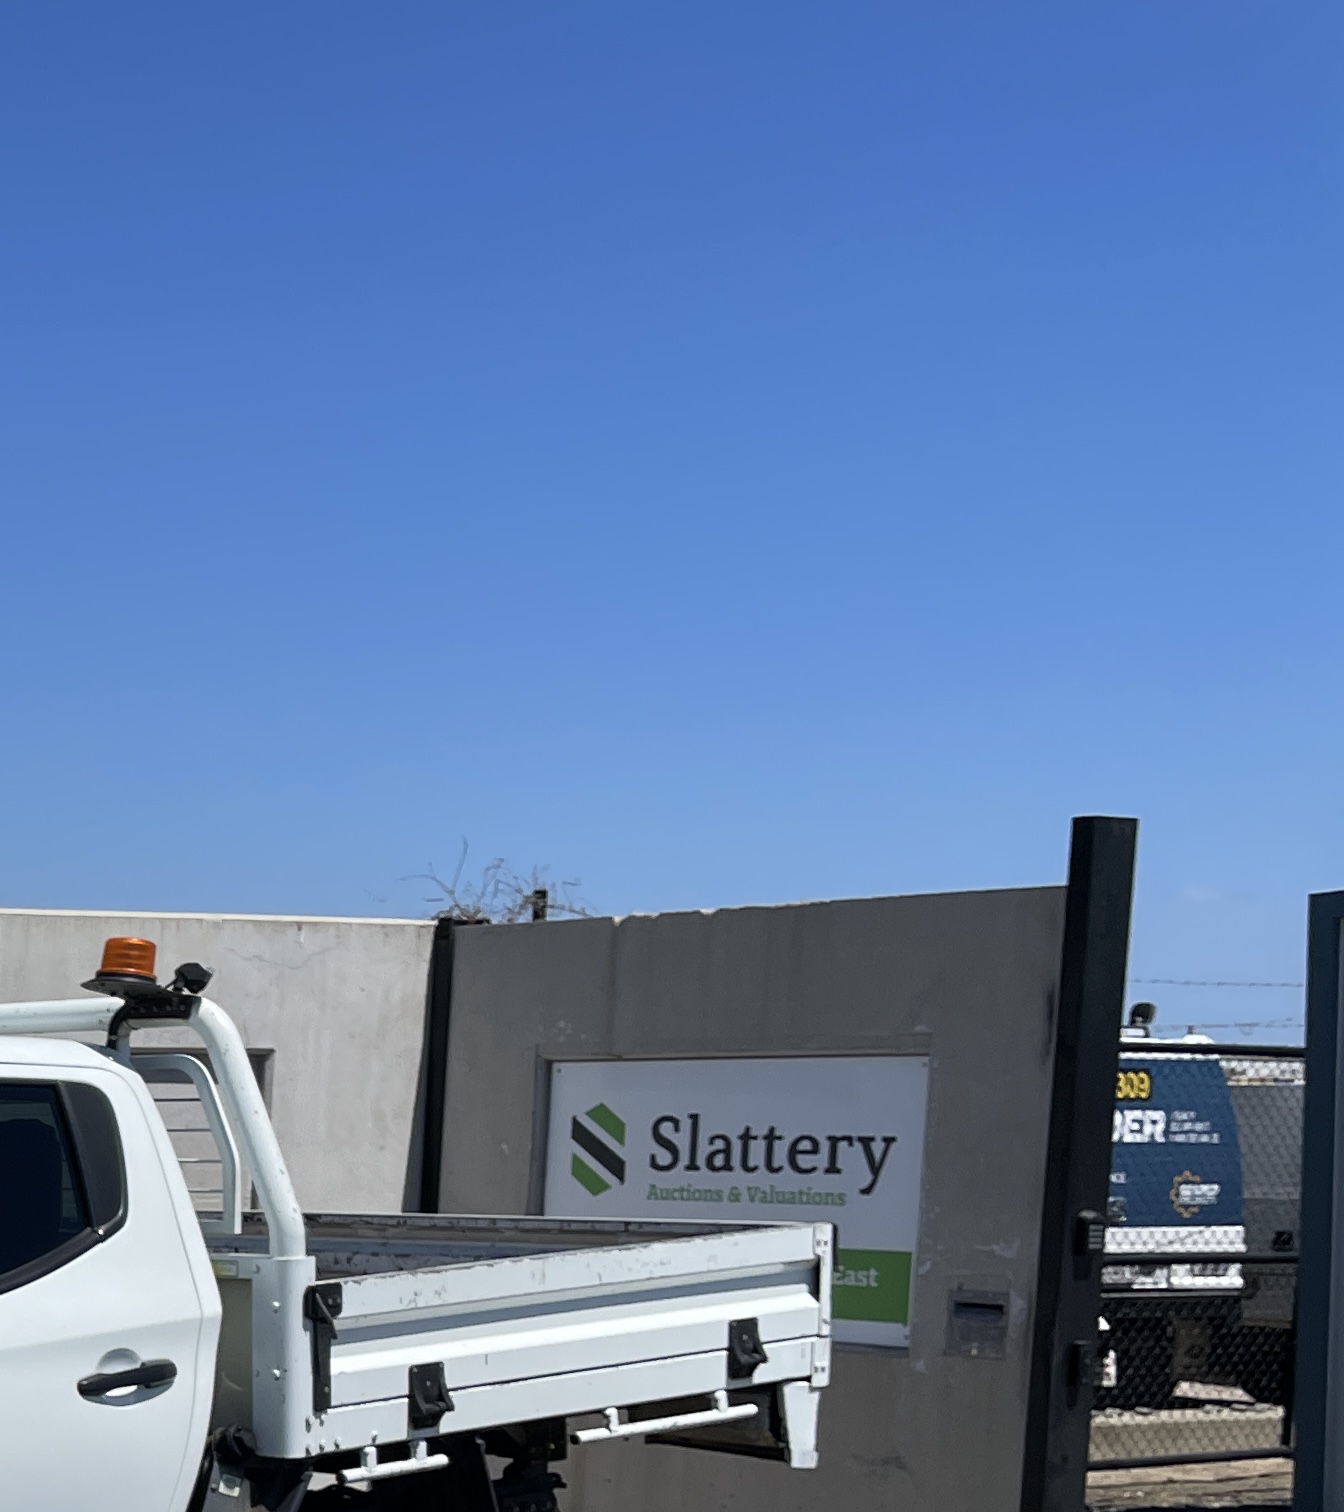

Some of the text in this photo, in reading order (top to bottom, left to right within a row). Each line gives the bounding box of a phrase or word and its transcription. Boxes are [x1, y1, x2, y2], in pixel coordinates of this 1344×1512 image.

[648, 1113, 898, 1195] Slattery
[647, 1183, 847, 1207] Auctions & Valuations
